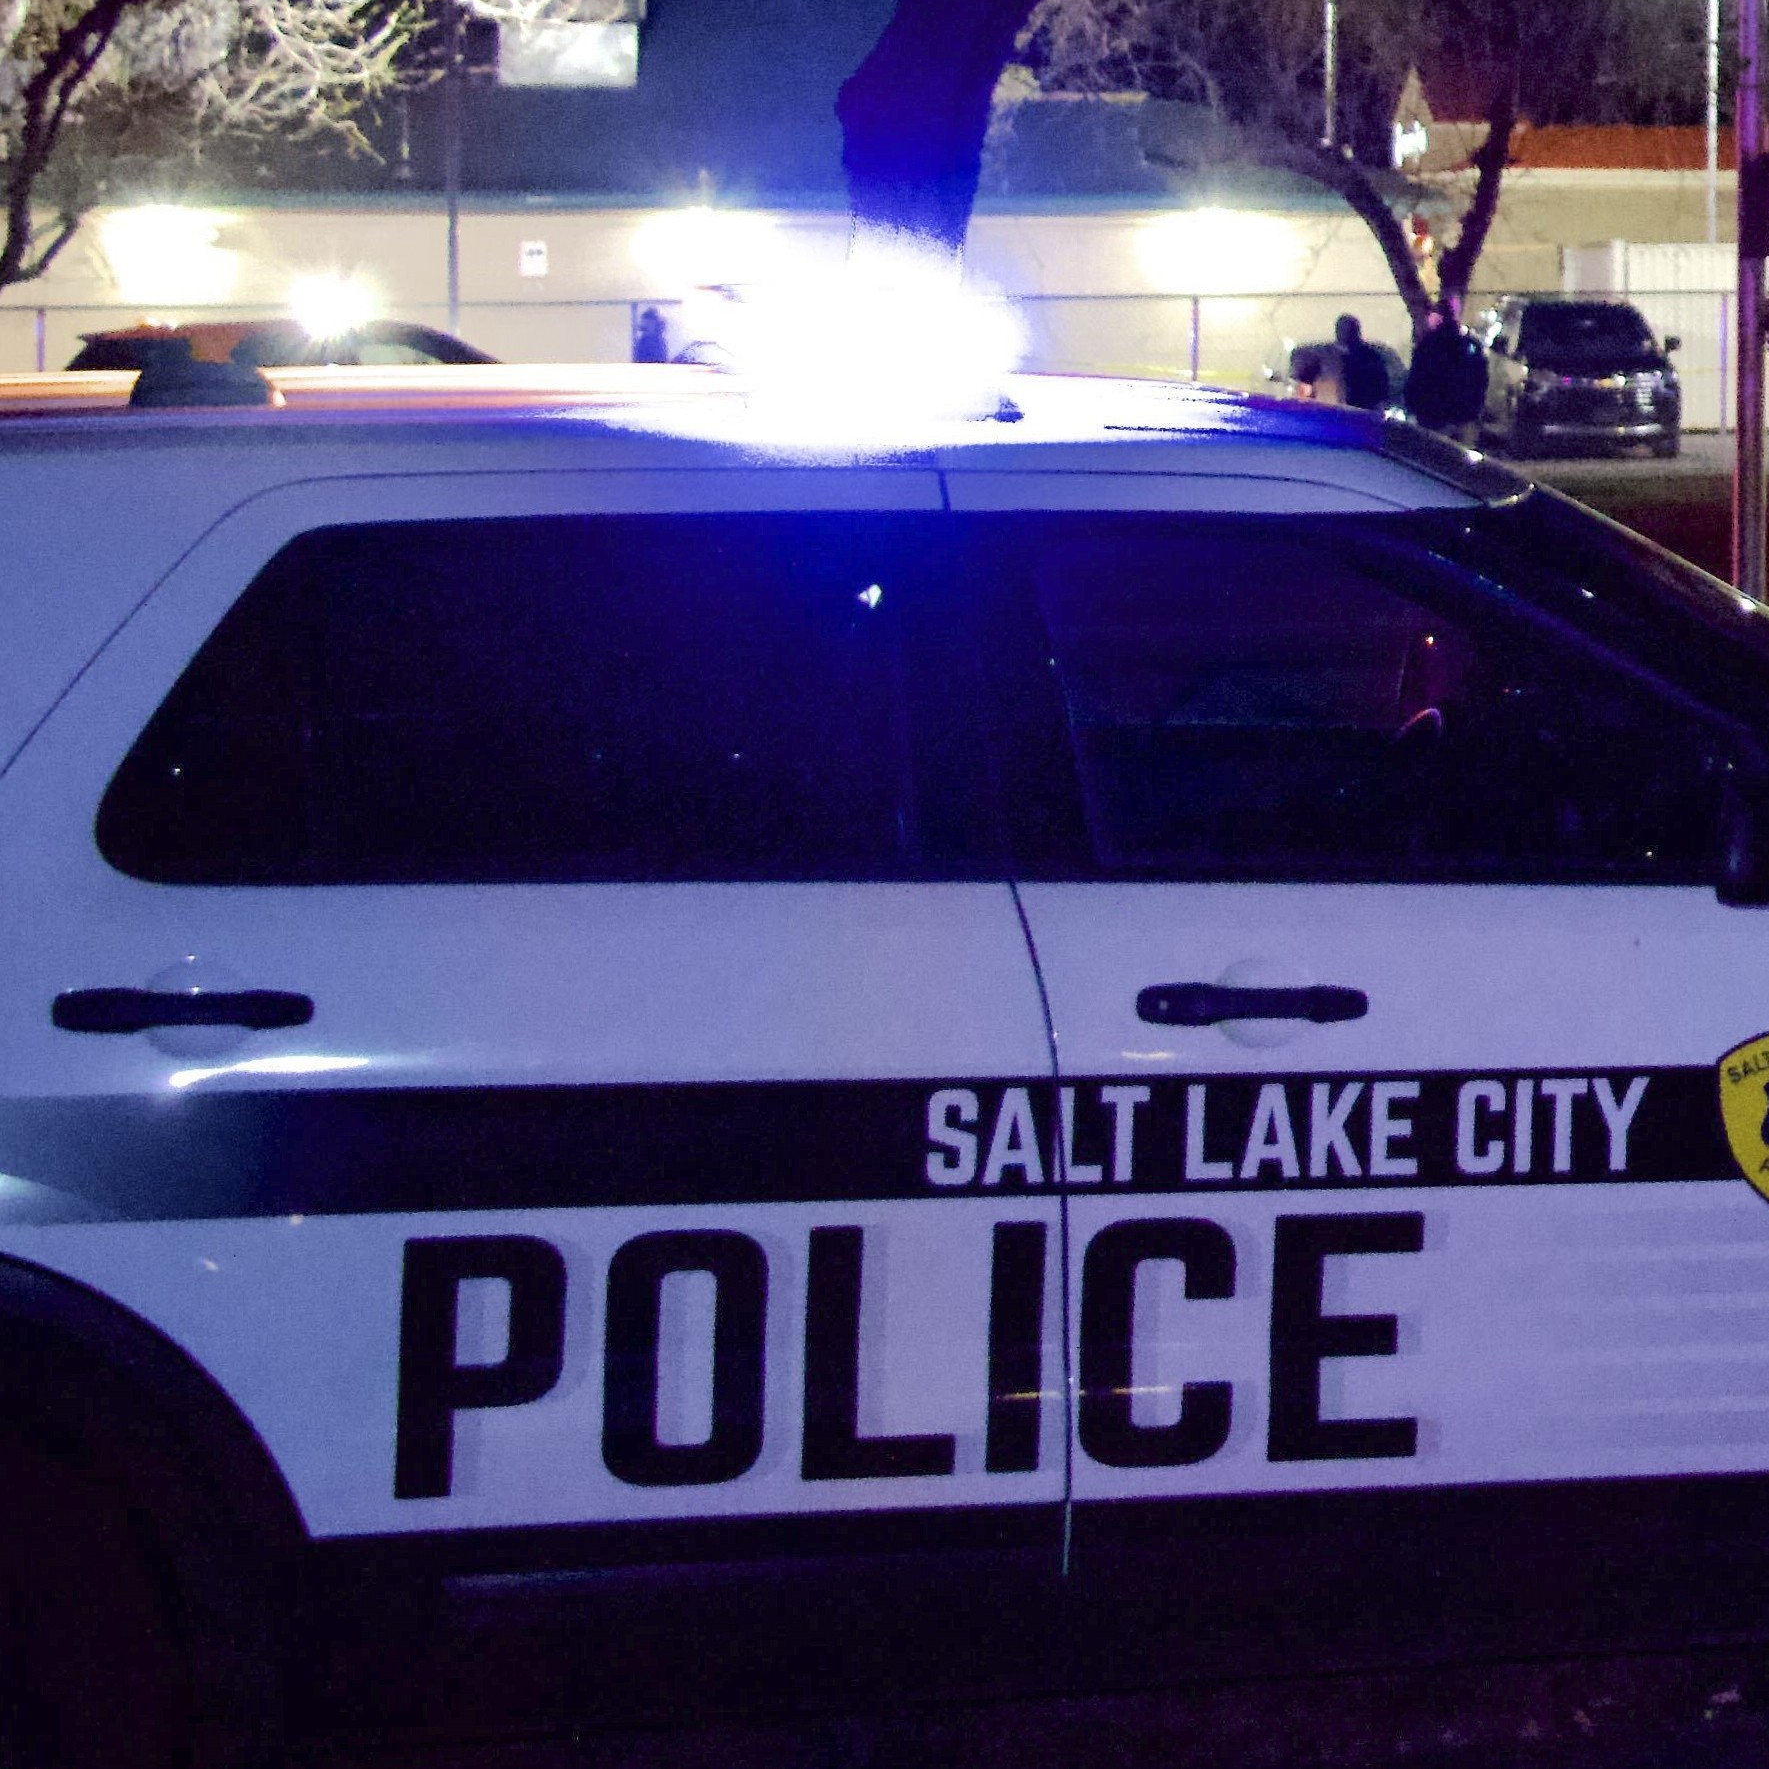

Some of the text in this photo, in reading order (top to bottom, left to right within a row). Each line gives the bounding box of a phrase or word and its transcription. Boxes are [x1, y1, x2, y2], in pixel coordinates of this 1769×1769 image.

[925, 1076, 1651, 1186] SALT LAKE CITY
[392, 1211, 1426, 1499] POLICE
